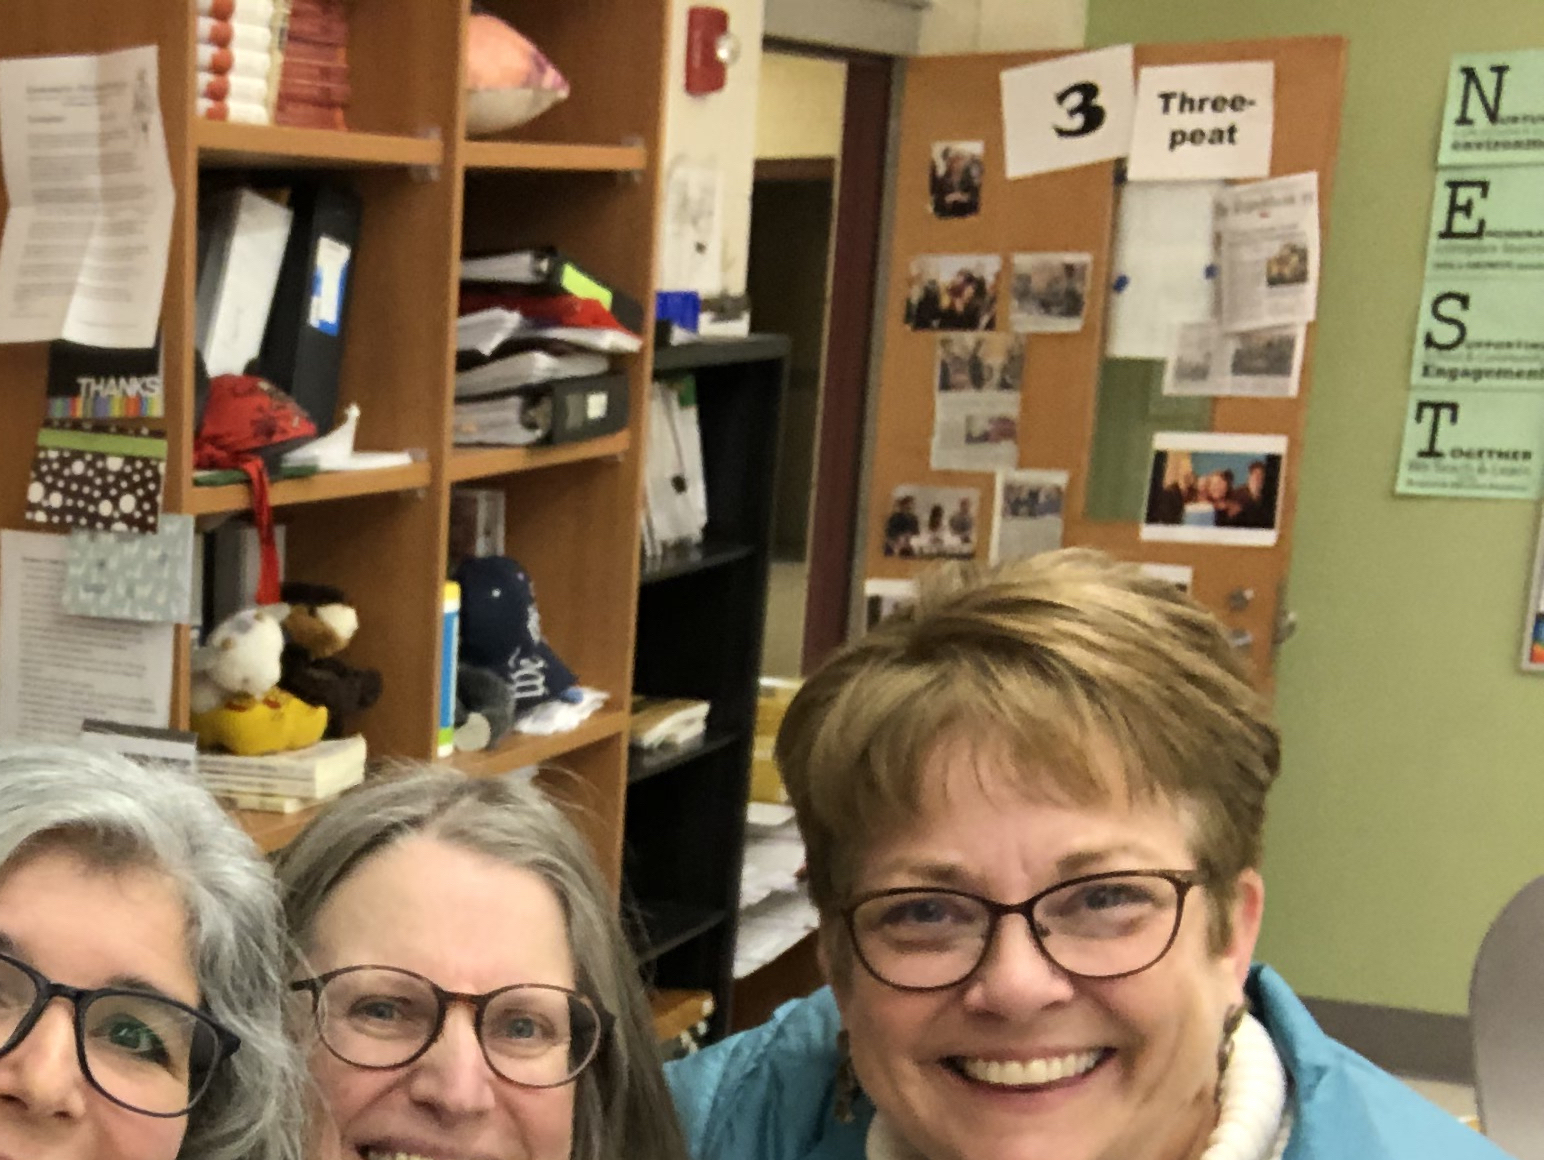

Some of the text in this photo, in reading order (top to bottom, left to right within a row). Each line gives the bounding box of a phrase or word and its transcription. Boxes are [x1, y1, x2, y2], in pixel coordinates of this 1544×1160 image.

[1052, 80, 1106, 138] 3
[1157, 91, 1257, 115] Three-
[1168, 123, 1239, 152] peat
[76, 376, 164, 398] THANKS
